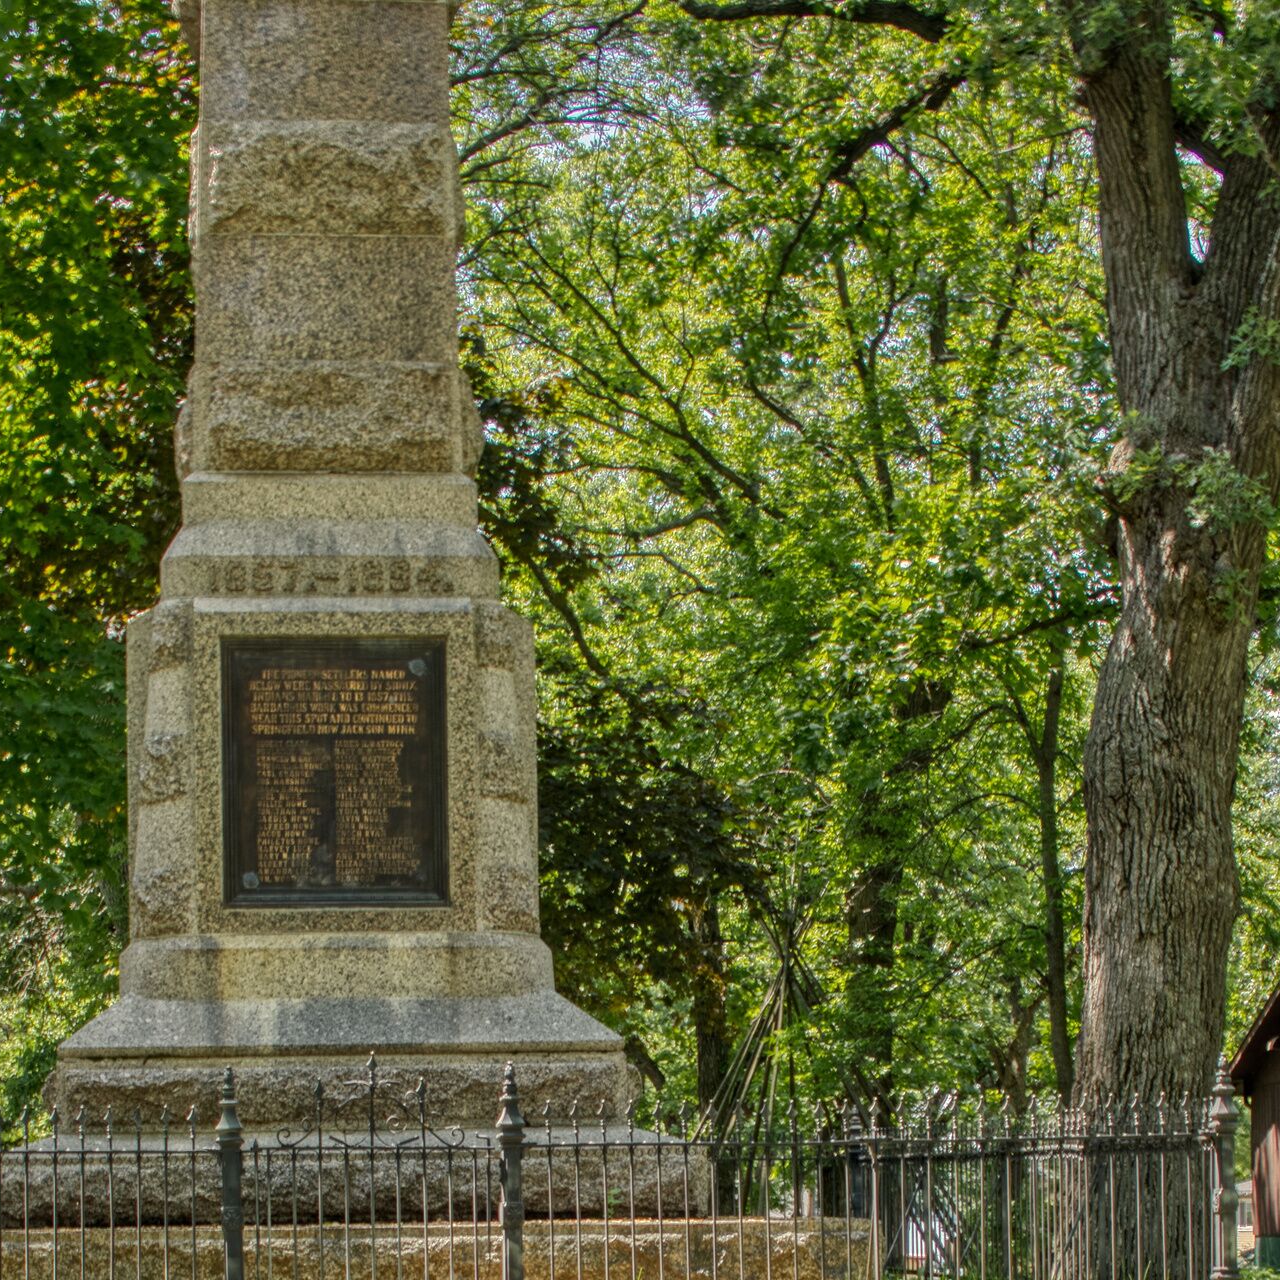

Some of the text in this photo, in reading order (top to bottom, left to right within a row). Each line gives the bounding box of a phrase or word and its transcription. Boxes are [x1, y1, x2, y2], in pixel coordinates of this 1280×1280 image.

[371, 669, 405, 680] NAMED
[249, 680, 280, 691] BELOW
[283, 680, 311, 691] WERE
[340, 691, 351, 701] TO
[339, 702, 358, 713] WAS
[251, 713, 277, 724] NEAR
[279, 713, 302, 724] THIS
[304, 713, 328, 724] SPOT
[329, 713, 350, 724] AND
[352, 713, 404, 724] CONTINUED
[252, 724, 315, 735] SPRINGFIELD
[341, 724, 384, 735] JACKSON
